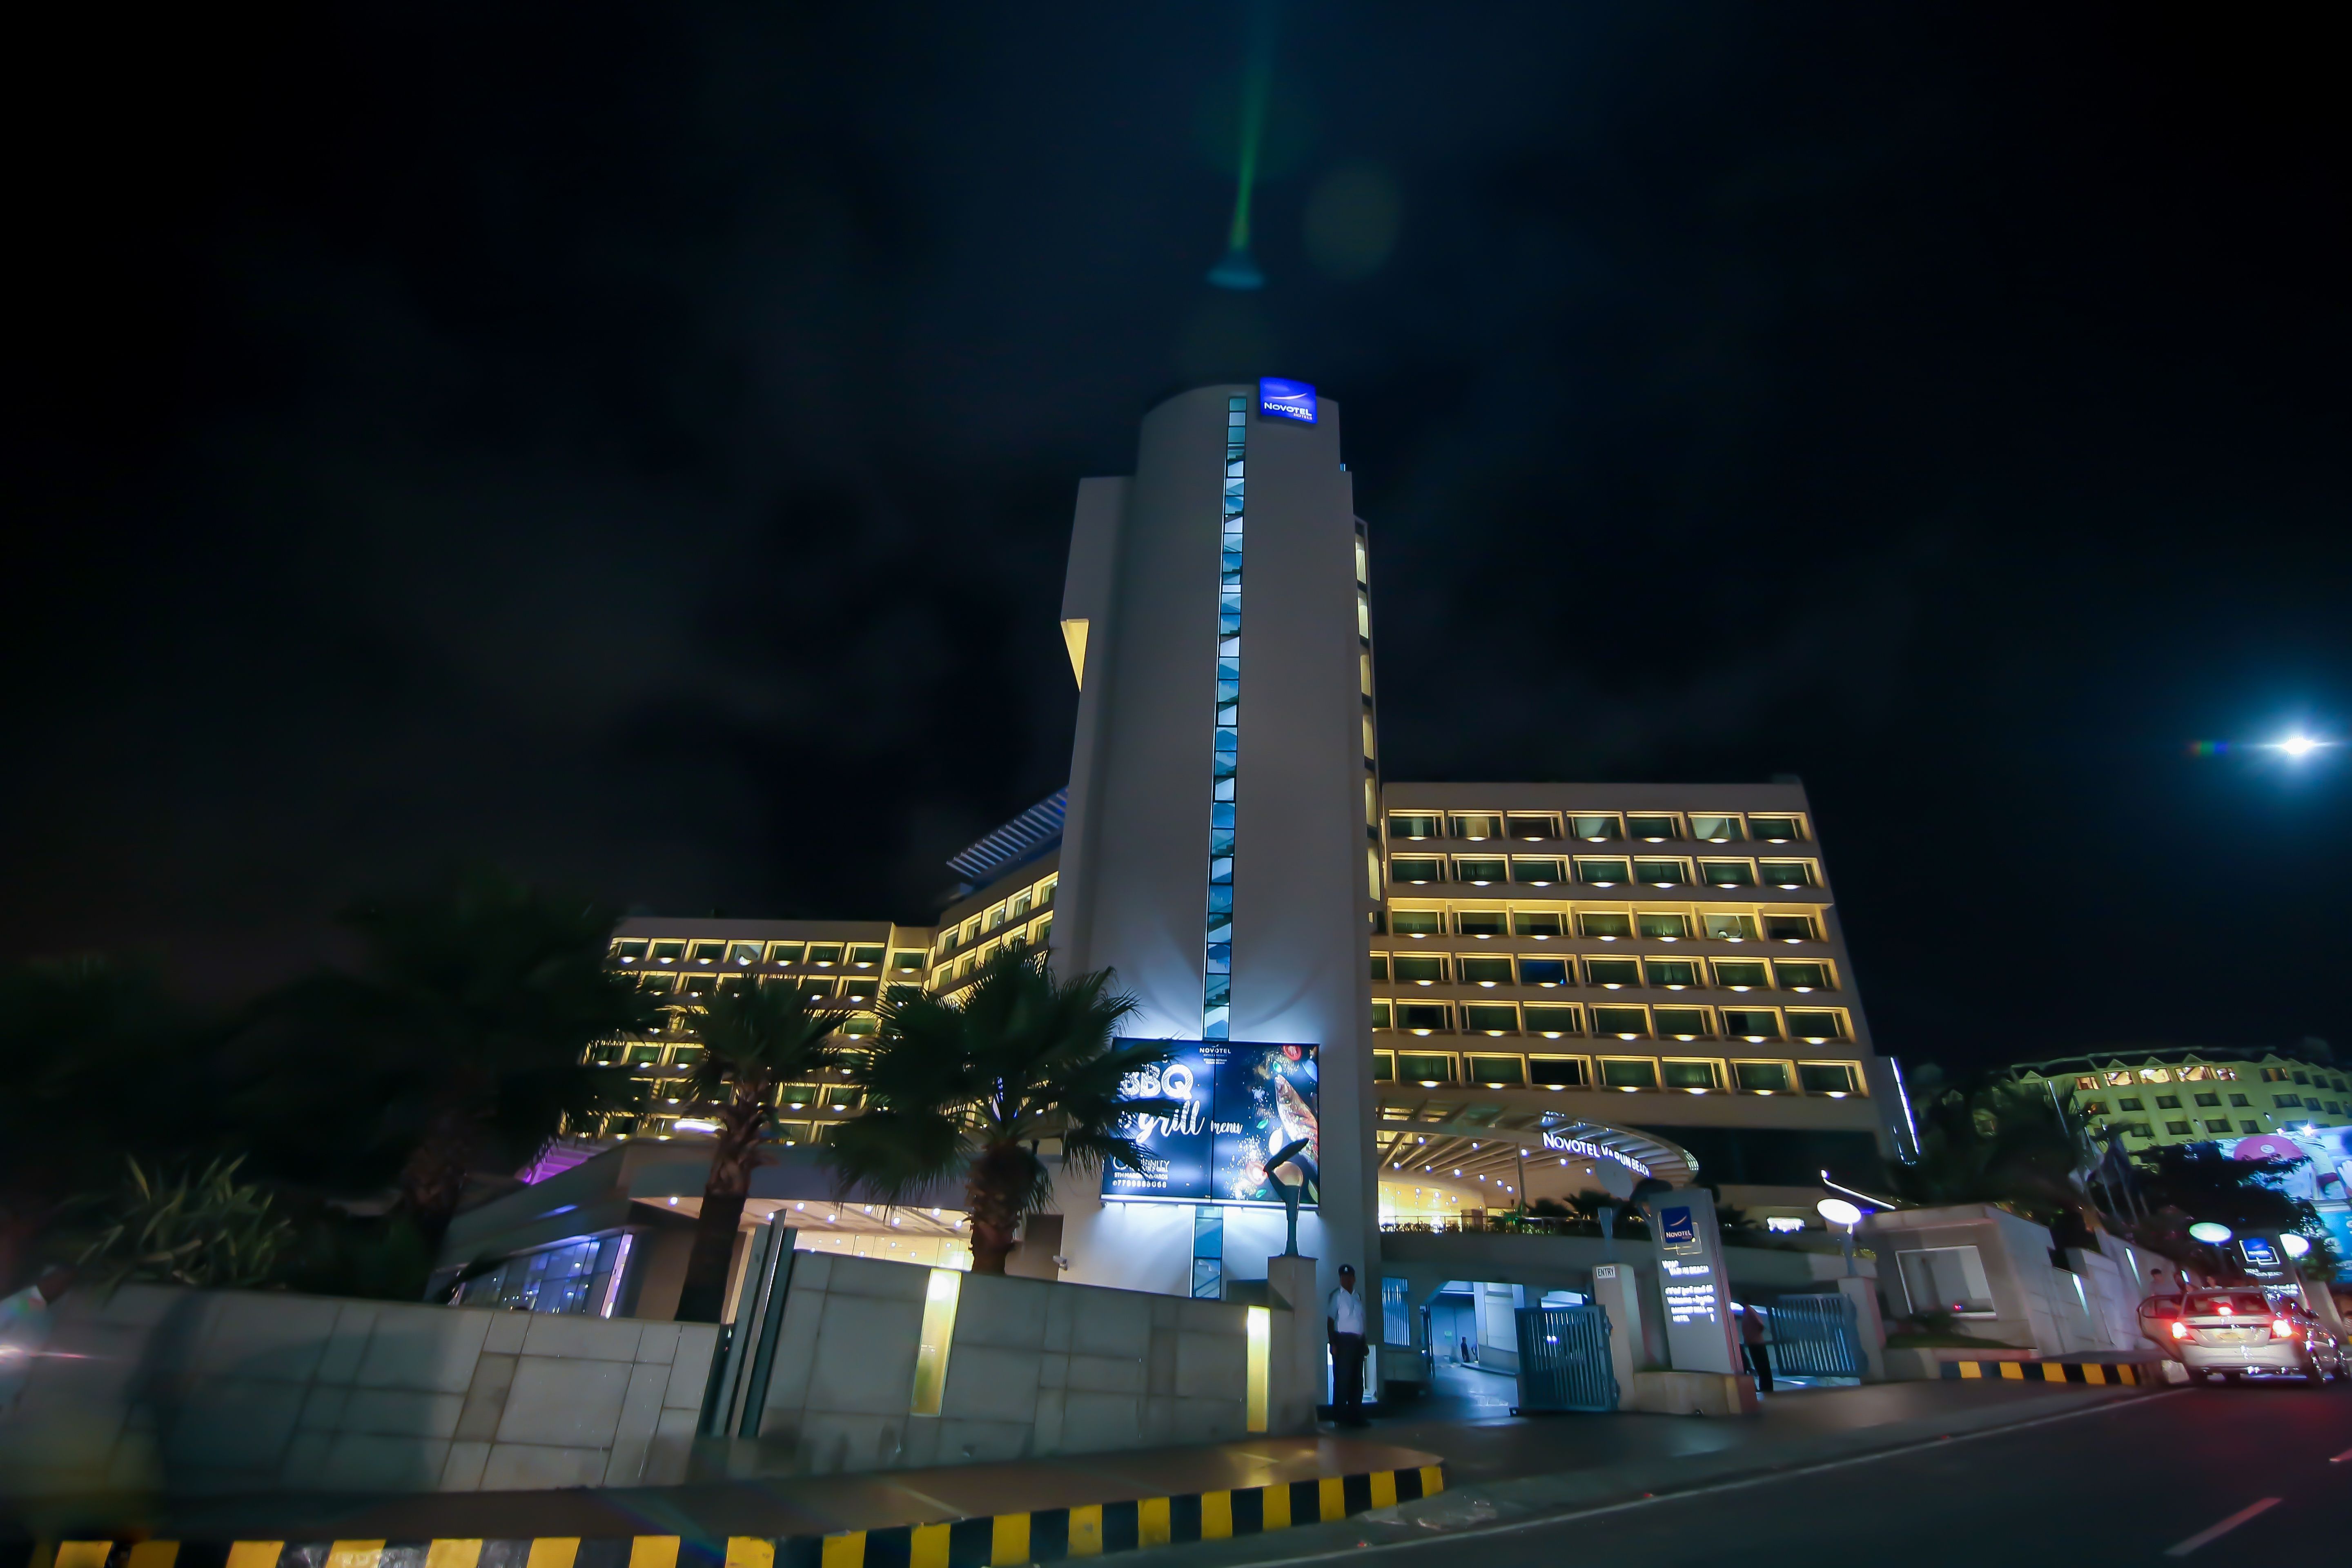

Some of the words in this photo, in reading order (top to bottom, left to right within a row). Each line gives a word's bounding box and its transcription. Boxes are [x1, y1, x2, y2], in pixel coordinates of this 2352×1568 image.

[1264, 402, 1312, 416] NOVOTEL
[1135, 1100, 1205, 1143] grill
[1210, 1120, 1243, 1134] menu
[1543, 1132, 1600, 1158] NOVOTEL
[1631, 1158, 1650, 1177] BEACH
[1666, 1230, 1691, 1238] NOVOTEL
[1597, 1268, 1613, 1276] ENTRY
